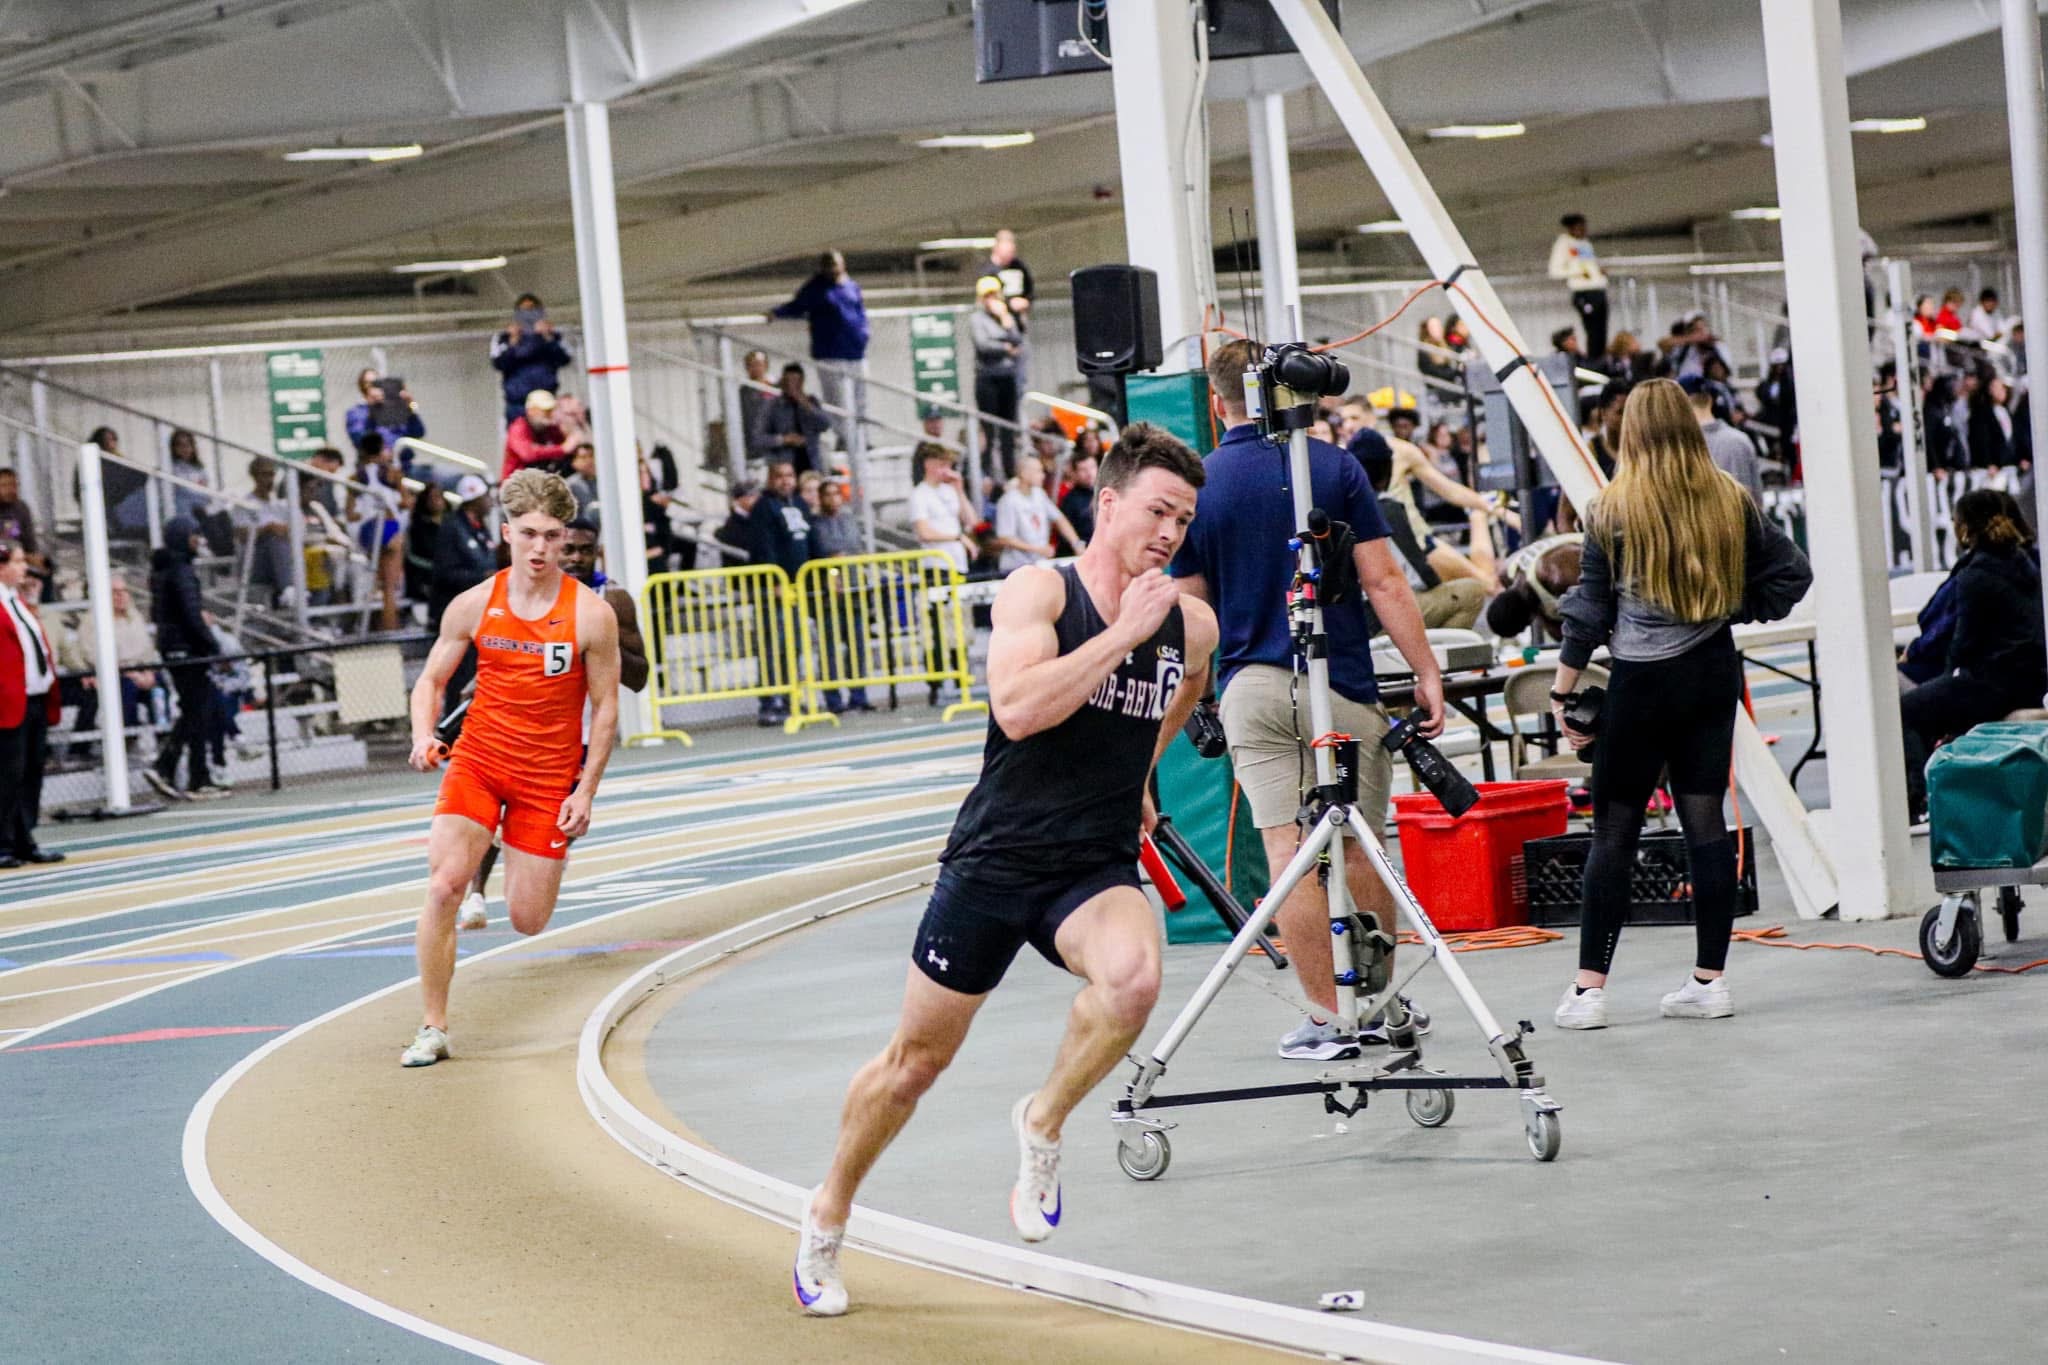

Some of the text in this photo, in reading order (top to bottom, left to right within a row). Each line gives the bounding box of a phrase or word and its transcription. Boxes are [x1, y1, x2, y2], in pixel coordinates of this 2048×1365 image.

[551, 645, 566, 674] 5
[1089, 672, 1161, 719] OIR-RHY
[1160, 666, 1181, 713] 6
